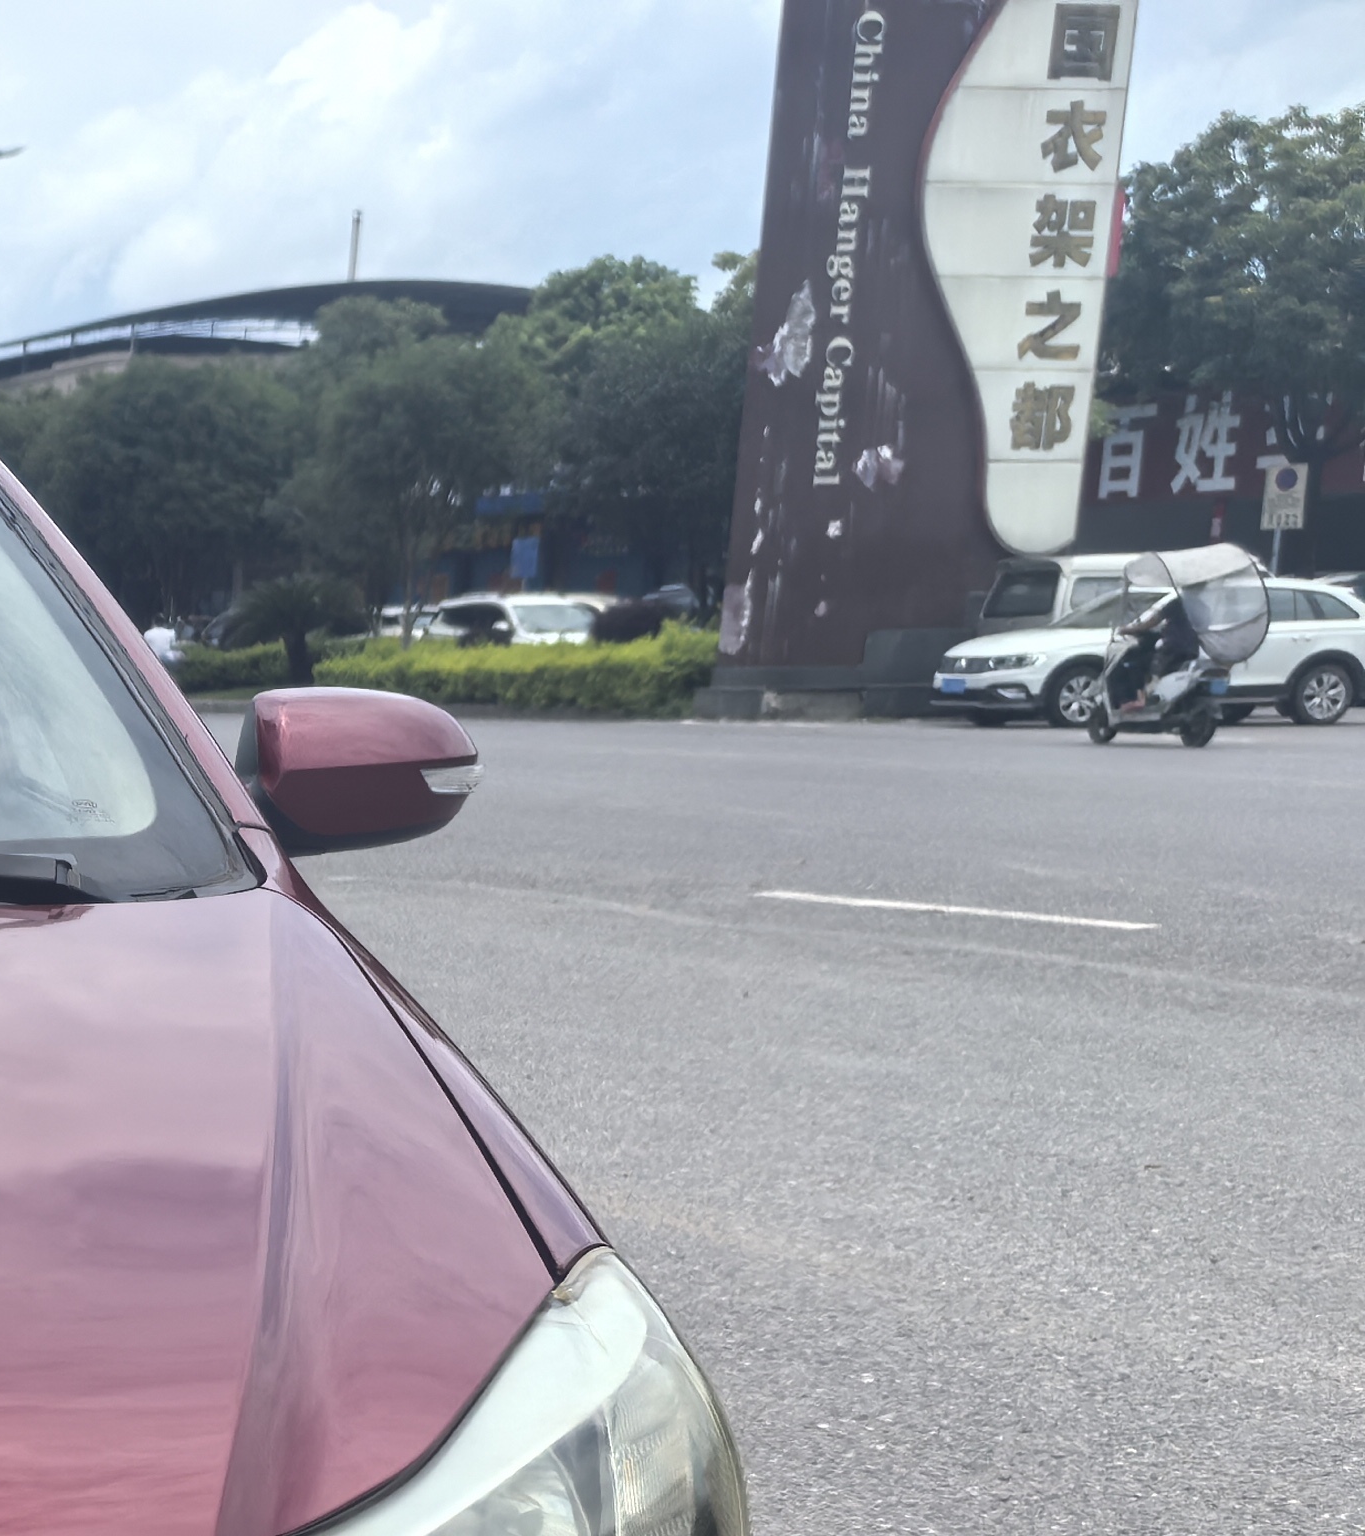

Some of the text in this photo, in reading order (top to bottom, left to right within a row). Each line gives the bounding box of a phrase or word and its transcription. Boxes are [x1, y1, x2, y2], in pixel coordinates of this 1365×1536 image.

[813, 10, 885, 487] China Hanger Capital
[1010, 3, 1120, 451] 国衣架之都
